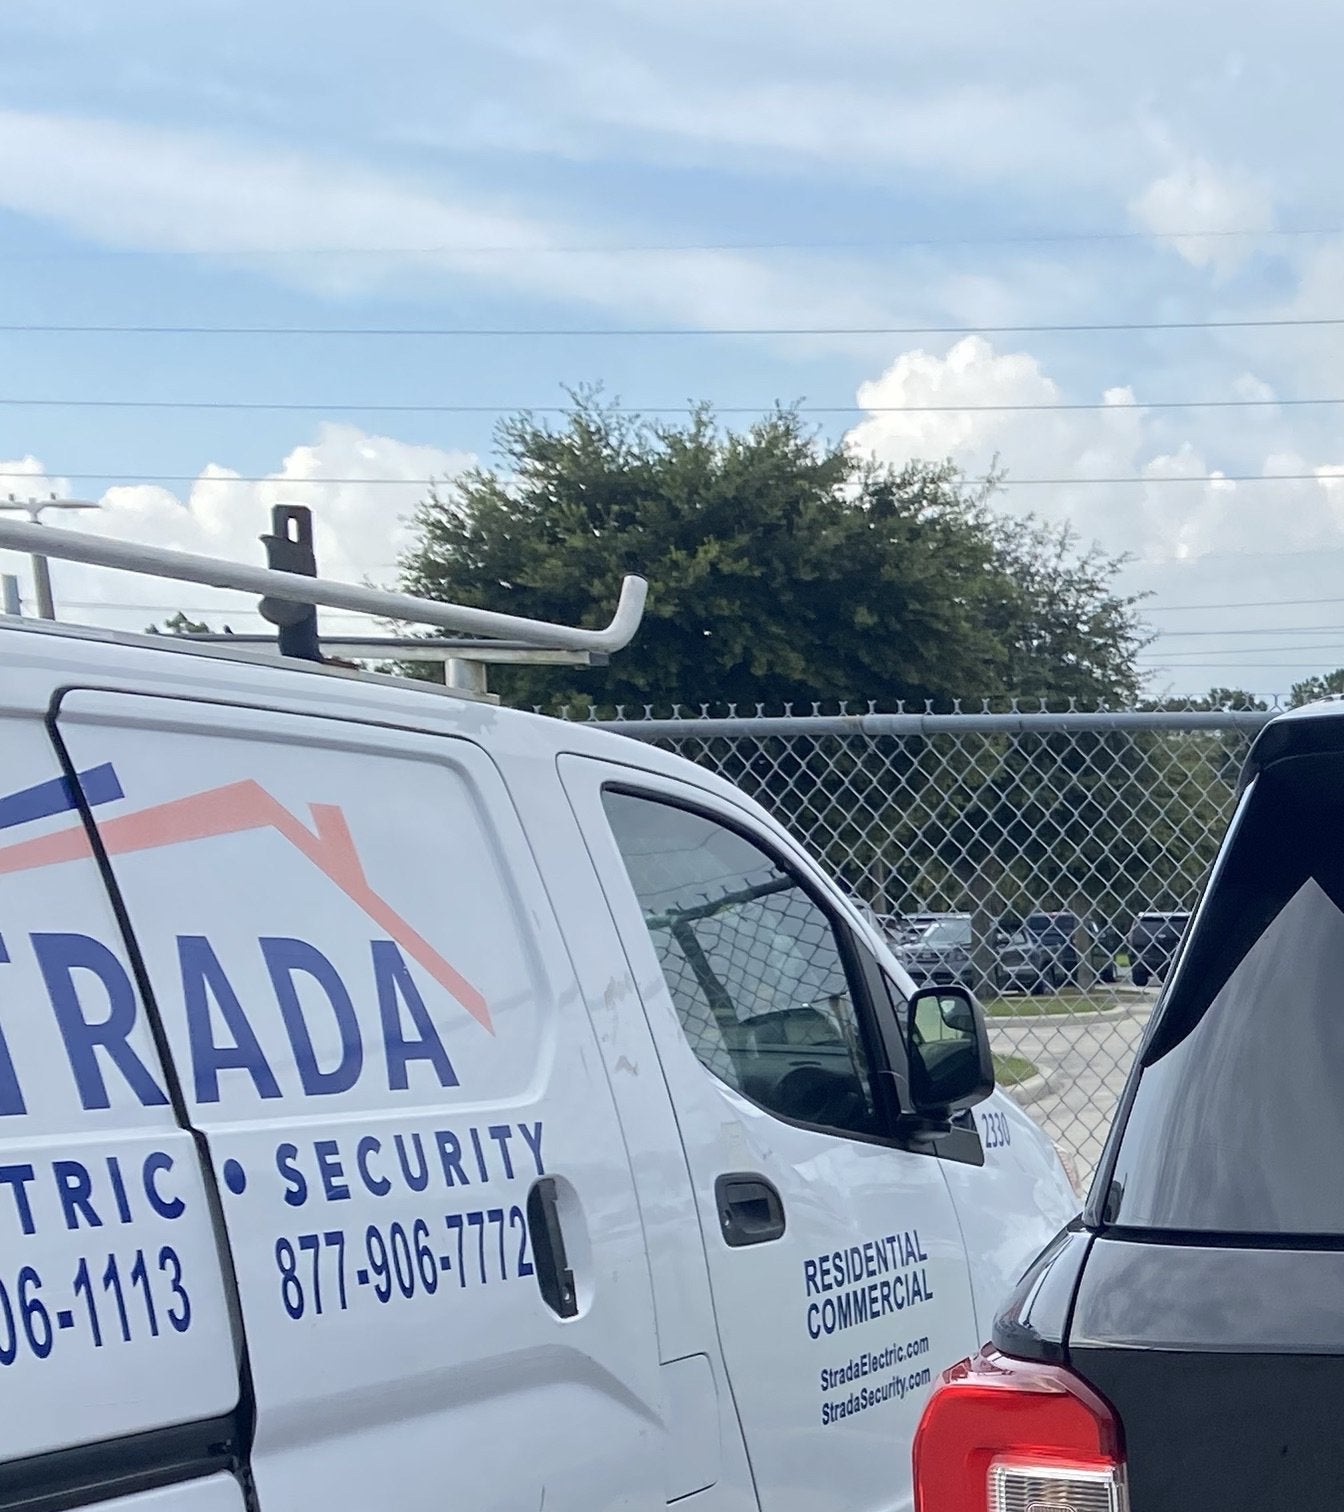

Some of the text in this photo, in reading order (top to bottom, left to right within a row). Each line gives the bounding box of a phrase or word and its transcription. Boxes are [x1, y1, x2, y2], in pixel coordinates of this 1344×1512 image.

[981, 1111, 1011, 1149] 2330
[0, 1121, 545, 1236] TRIC SECURITY
[275, 1205, 535, 1320] 877-906-7772
[803, 1229, 928, 1298] RESIDENTIAL
[807, 1268, 934, 1340] COMMERCIAL
[820, 1336, 930, 1391] StradaElectric.com
[822, 1367, 932, 1425] StradaSecurity.com
